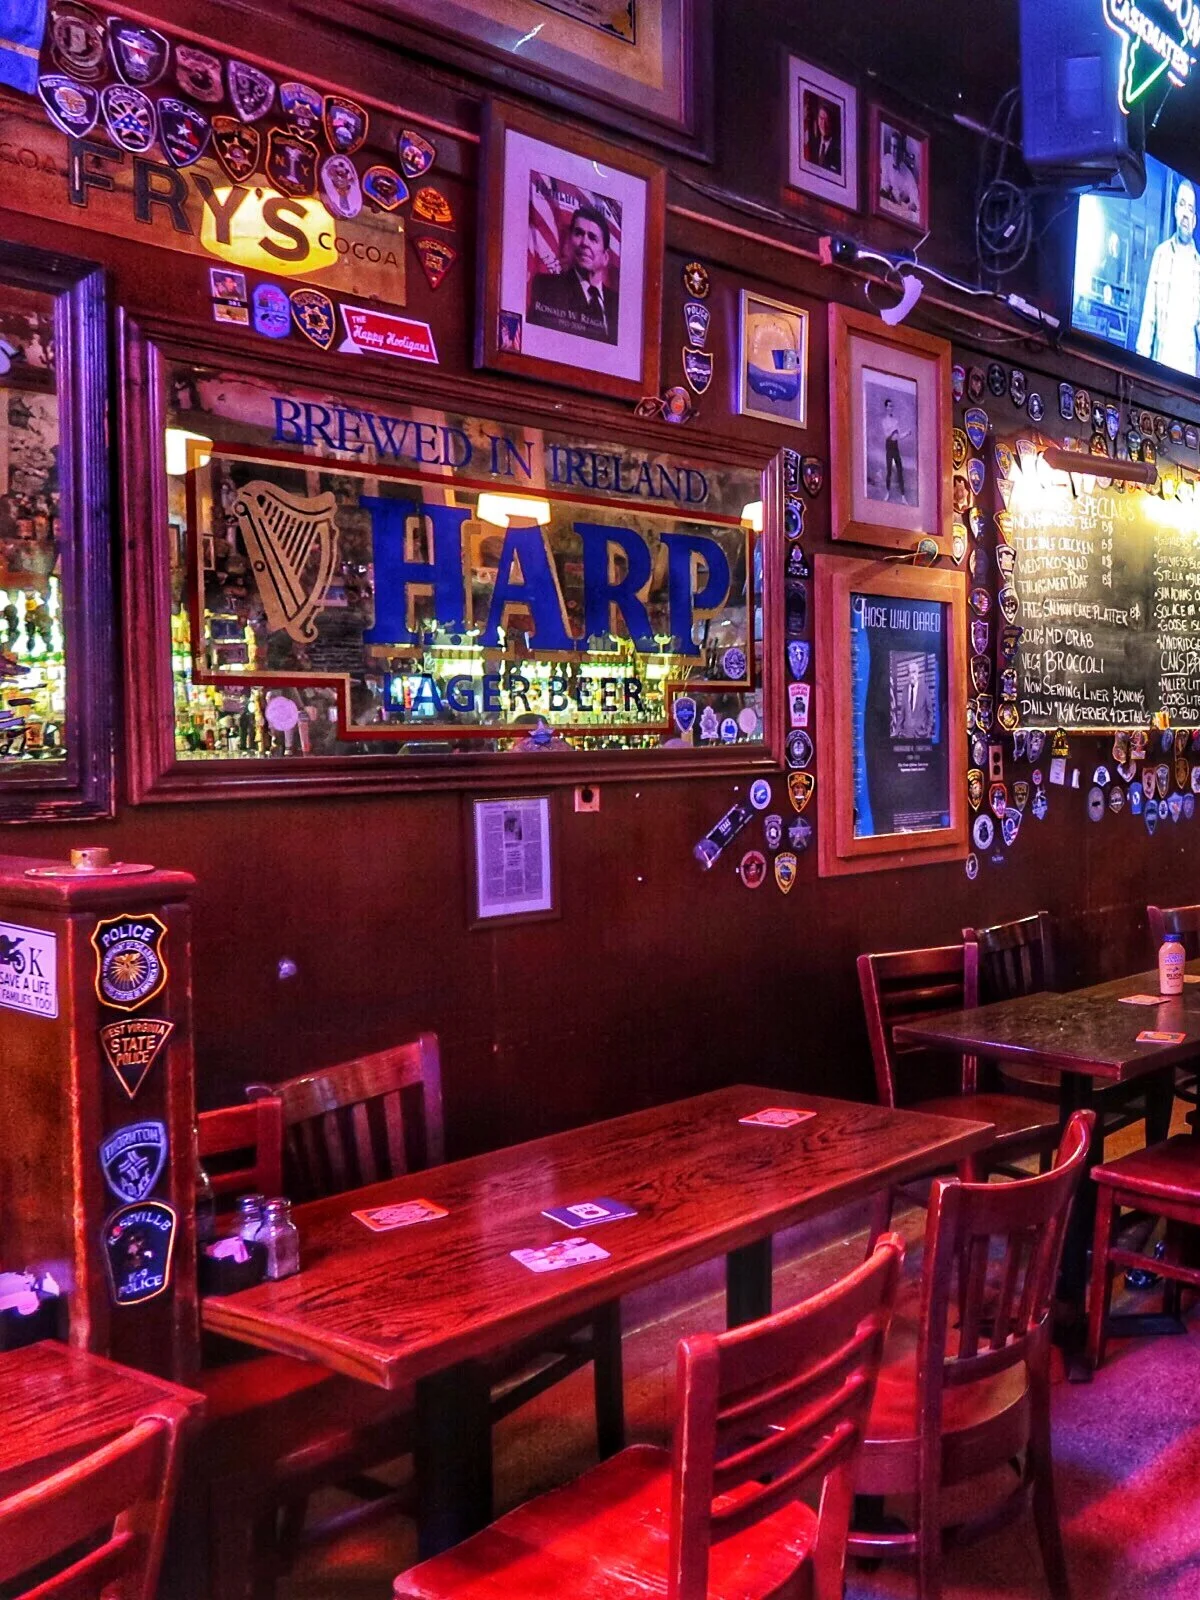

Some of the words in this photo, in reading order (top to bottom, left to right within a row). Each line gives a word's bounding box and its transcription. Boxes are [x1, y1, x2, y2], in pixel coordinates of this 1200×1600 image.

[1110, 0, 1190, 77] CASKMATES
[162, 101, 208, 128] POLICE
[69, 139, 310, 262] FRY'S
[318, 232, 399, 269] COCOA
[351, 315, 367, 325] THE
[535, 301, 566, 318] RONALD
[581, 313, 608, 330] REAGA
[687, 306, 709, 320] POLICE
[353, 325, 385, 347] Happy
[271, 396, 473, 468] BREWED
[484, 433, 535, 480] IN
[549, 443, 709, 504] IRELAND
[1078, 492, 1136, 522] SPECIALS
[358, 495, 731, 654] HARP
[1060, 555, 1089, 571] SALAD
[1156, 566, 1184, 582] STELLA
[852, 596, 888, 630] THOSE
[889, 608, 911, 630] WHO
[912, 610, 940, 633] DARED
[1042, 598, 1072, 618] SALMON
[1093, 604, 1128, 626] PLATTER
[1155, 603, 1186, 619] SOLACE
[1160, 618, 1188, 632] GOOSE
[1045, 626, 1063, 645] MD
[1065, 628, 1095, 649] CRAB
[1043, 649, 1104, 674] BROCCOLI
[383, 673, 532, 713] LAGER
[549, 674, 645, 713] BEER
[1023, 675, 1042, 694] NOW
[1042, 674, 1081, 700] SERVING
[1083, 682, 1109, 703] LIVER
[1118, 688, 1146, 706] ONIONS
[1161, 677, 1187, 692] MILLER
[1161, 692, 1186, 706] COORS
[1020, 699, 1053, 716] DAILY
[1075, 703, 1110, 723] SERVER
[1115, 708, 1151, 724] DETAILS
[1181, 706, 1199, 721] BUD
[101, 923, 155, 948] POLICE
[23, 977, 29, 990] A
[127, 1022, 165, 1036] VIRGINIA
[110, 1034, 157, 1053] STATE
[116, 1050, 150, 1067] POLICE
[104, 1127, 160, 1160] THORNTON
[118, 1274, 163, 1298] POLICE
